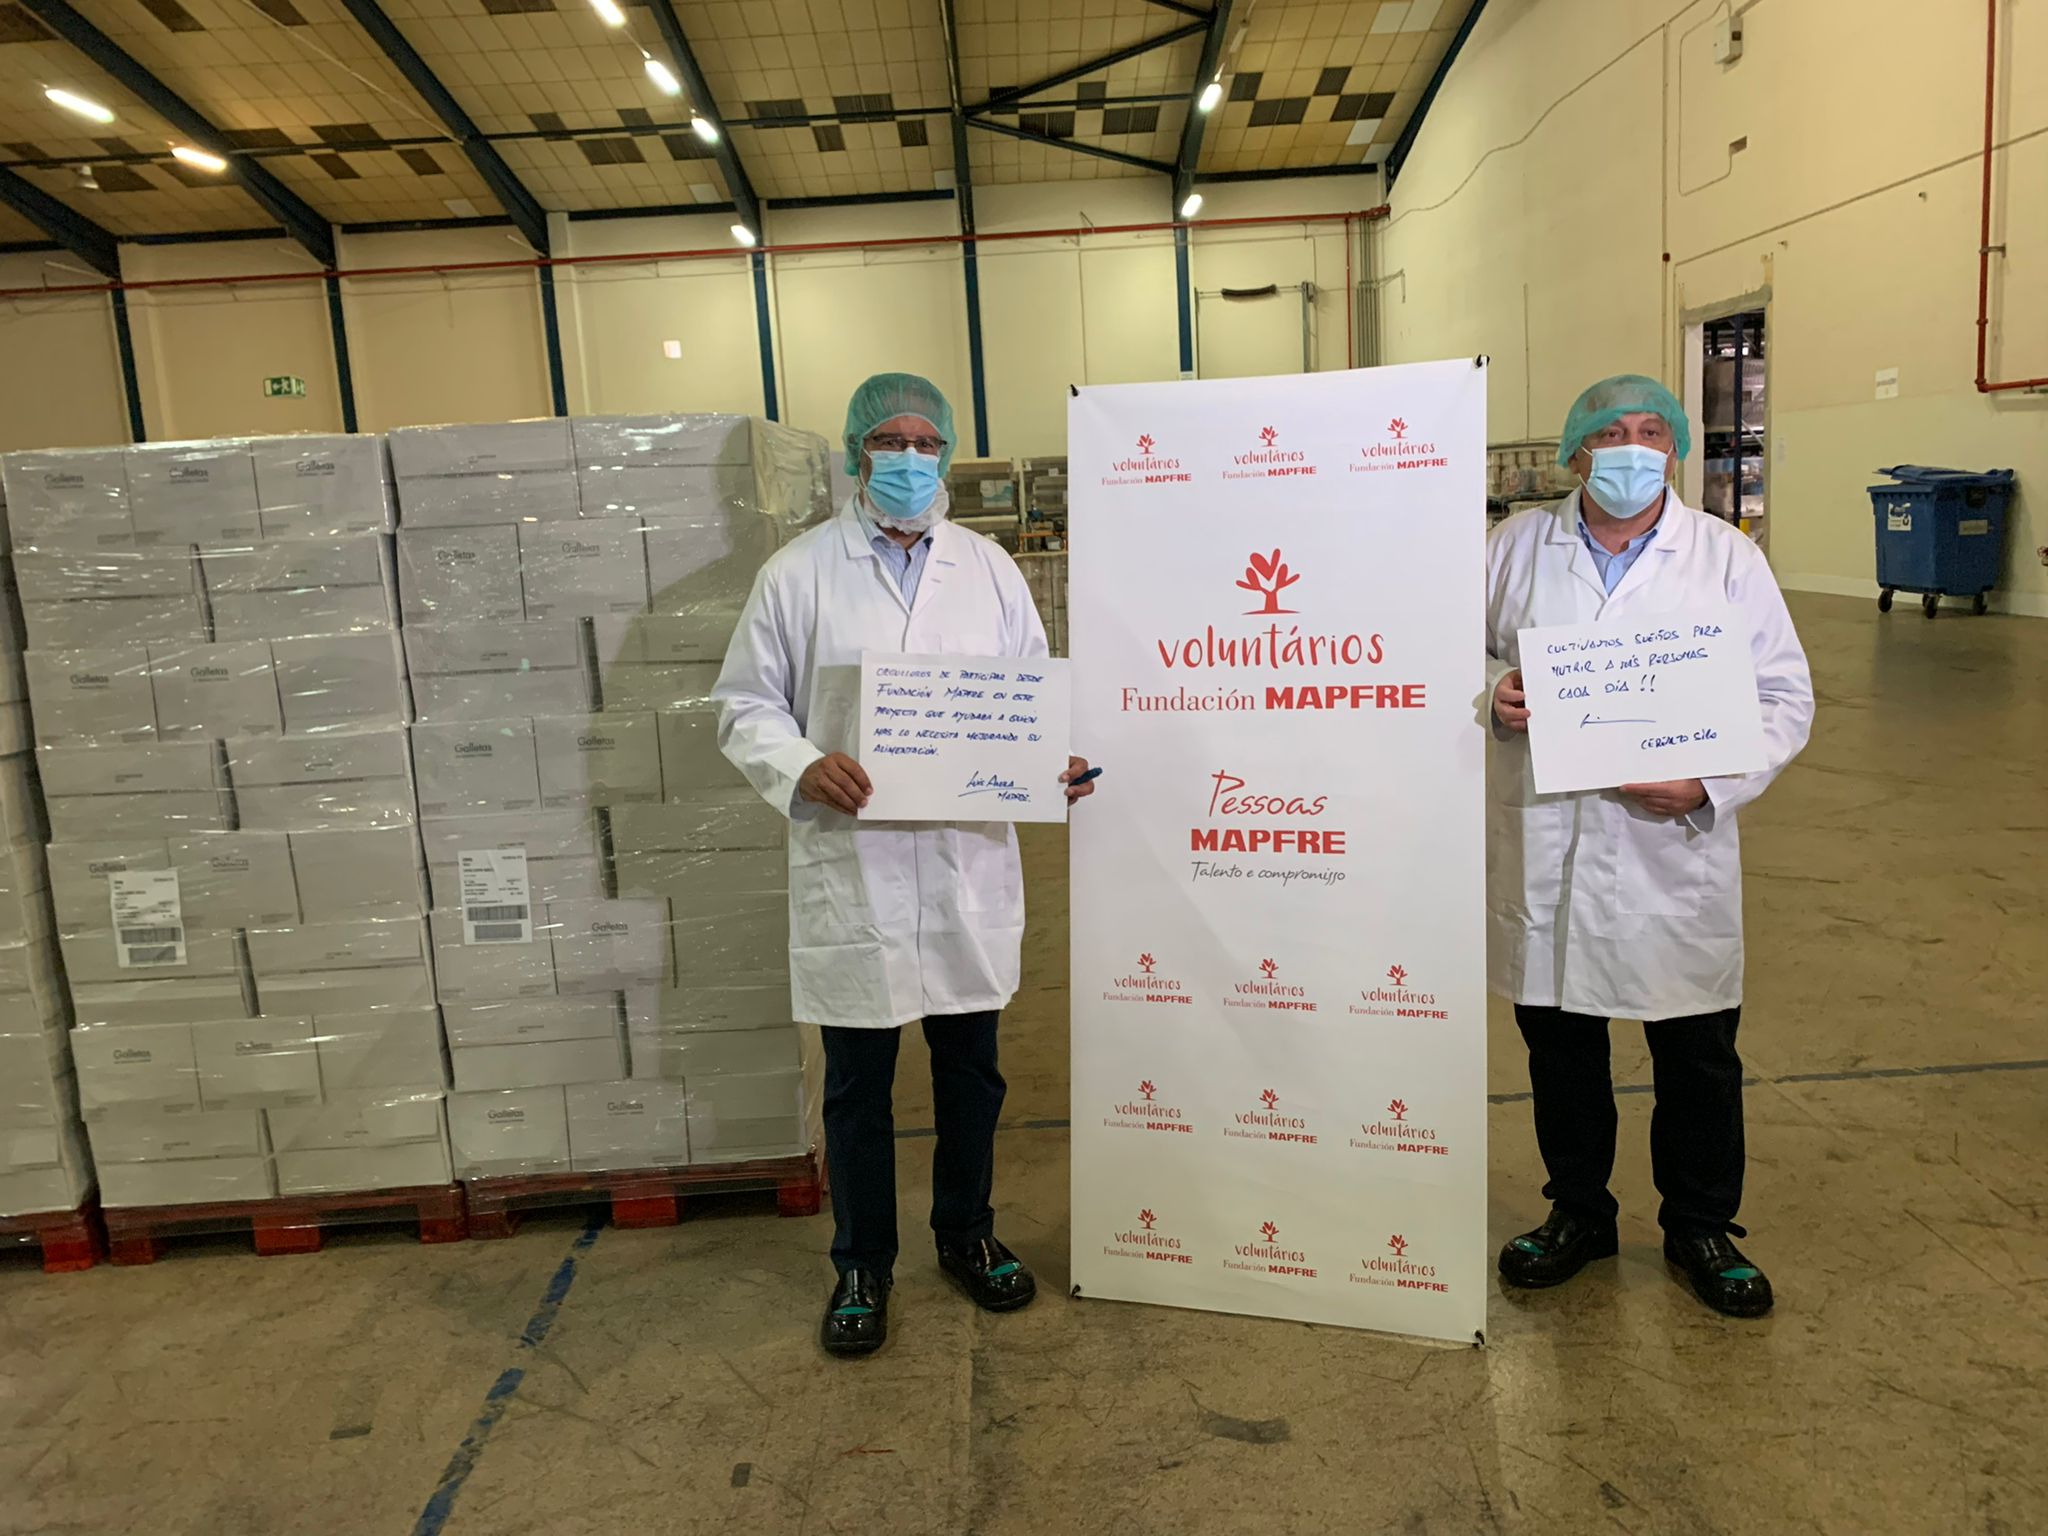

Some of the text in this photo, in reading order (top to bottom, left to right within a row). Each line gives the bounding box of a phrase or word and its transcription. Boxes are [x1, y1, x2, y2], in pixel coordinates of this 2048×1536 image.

[1234, 450, 1304, 464] voluntários
[1362, 442, 1435, 457] voluntários
[1113, 457, 1179, 471] voluntários
[1350, 458, 1447, 472] Fundación MAPFRE
[1102, 474, 1190, 485] Fundación MAPFRE
[1223, 467, 1317, 479] Fundación MAPFRE
[1158, 624, 1383, 669] voluntários
[1605, 660, 1614, 670] A
[1123, 685, 1425, 711] Fundación MAPFRE
[454, 742, 493, 753] Galletas
[577, 736, 616, 748] Galletas
[1209, 770, 1327, 816] Pessoas
[1191, 829, 1345, 854] MAPFRE
[1192, 861, 1242, 881] Talento
[1258, 868, 1345, 886] compromisso
[1114, 975, 1180, 990] voluntários
[1235, 981, 1304, 996] voluntários
[1103, 992, 1192, 1004] Fundación MAPFRE
[1362, 988, 1434, 1004] voluntários
[1224, 998, 1316, 1011] Fundación MAPFRE
[1349, 1005, 1448, 1019] Fundación MAPFRE
[1115, 1102, 1181, 1118] voluntários
[1104, 1119, 1192, 1132] Fundación MAPFRE
[1236, 1111, 1304, 1128] voluntários
[1224, 1128, 1316, 1143] Fundación MAPFRE
[1362, 1122, 1435, 1139] voluntários
[1350, 1139, 1448, 1154] Fundación MAPFRE
[1115, 1230, 1180, 1250] voluntários
[1104, 1246, 1192, 1263] Fundación MAPFRE
[1235, 1242, 1304, 1263] voluntários
[1224, 1260, 1316, 1277] Fundación MAPFRE
[1362, 1257, 1435, 1278] voluntários
[1350, 1273, 1448, 1292] Fundación MAPFRE
